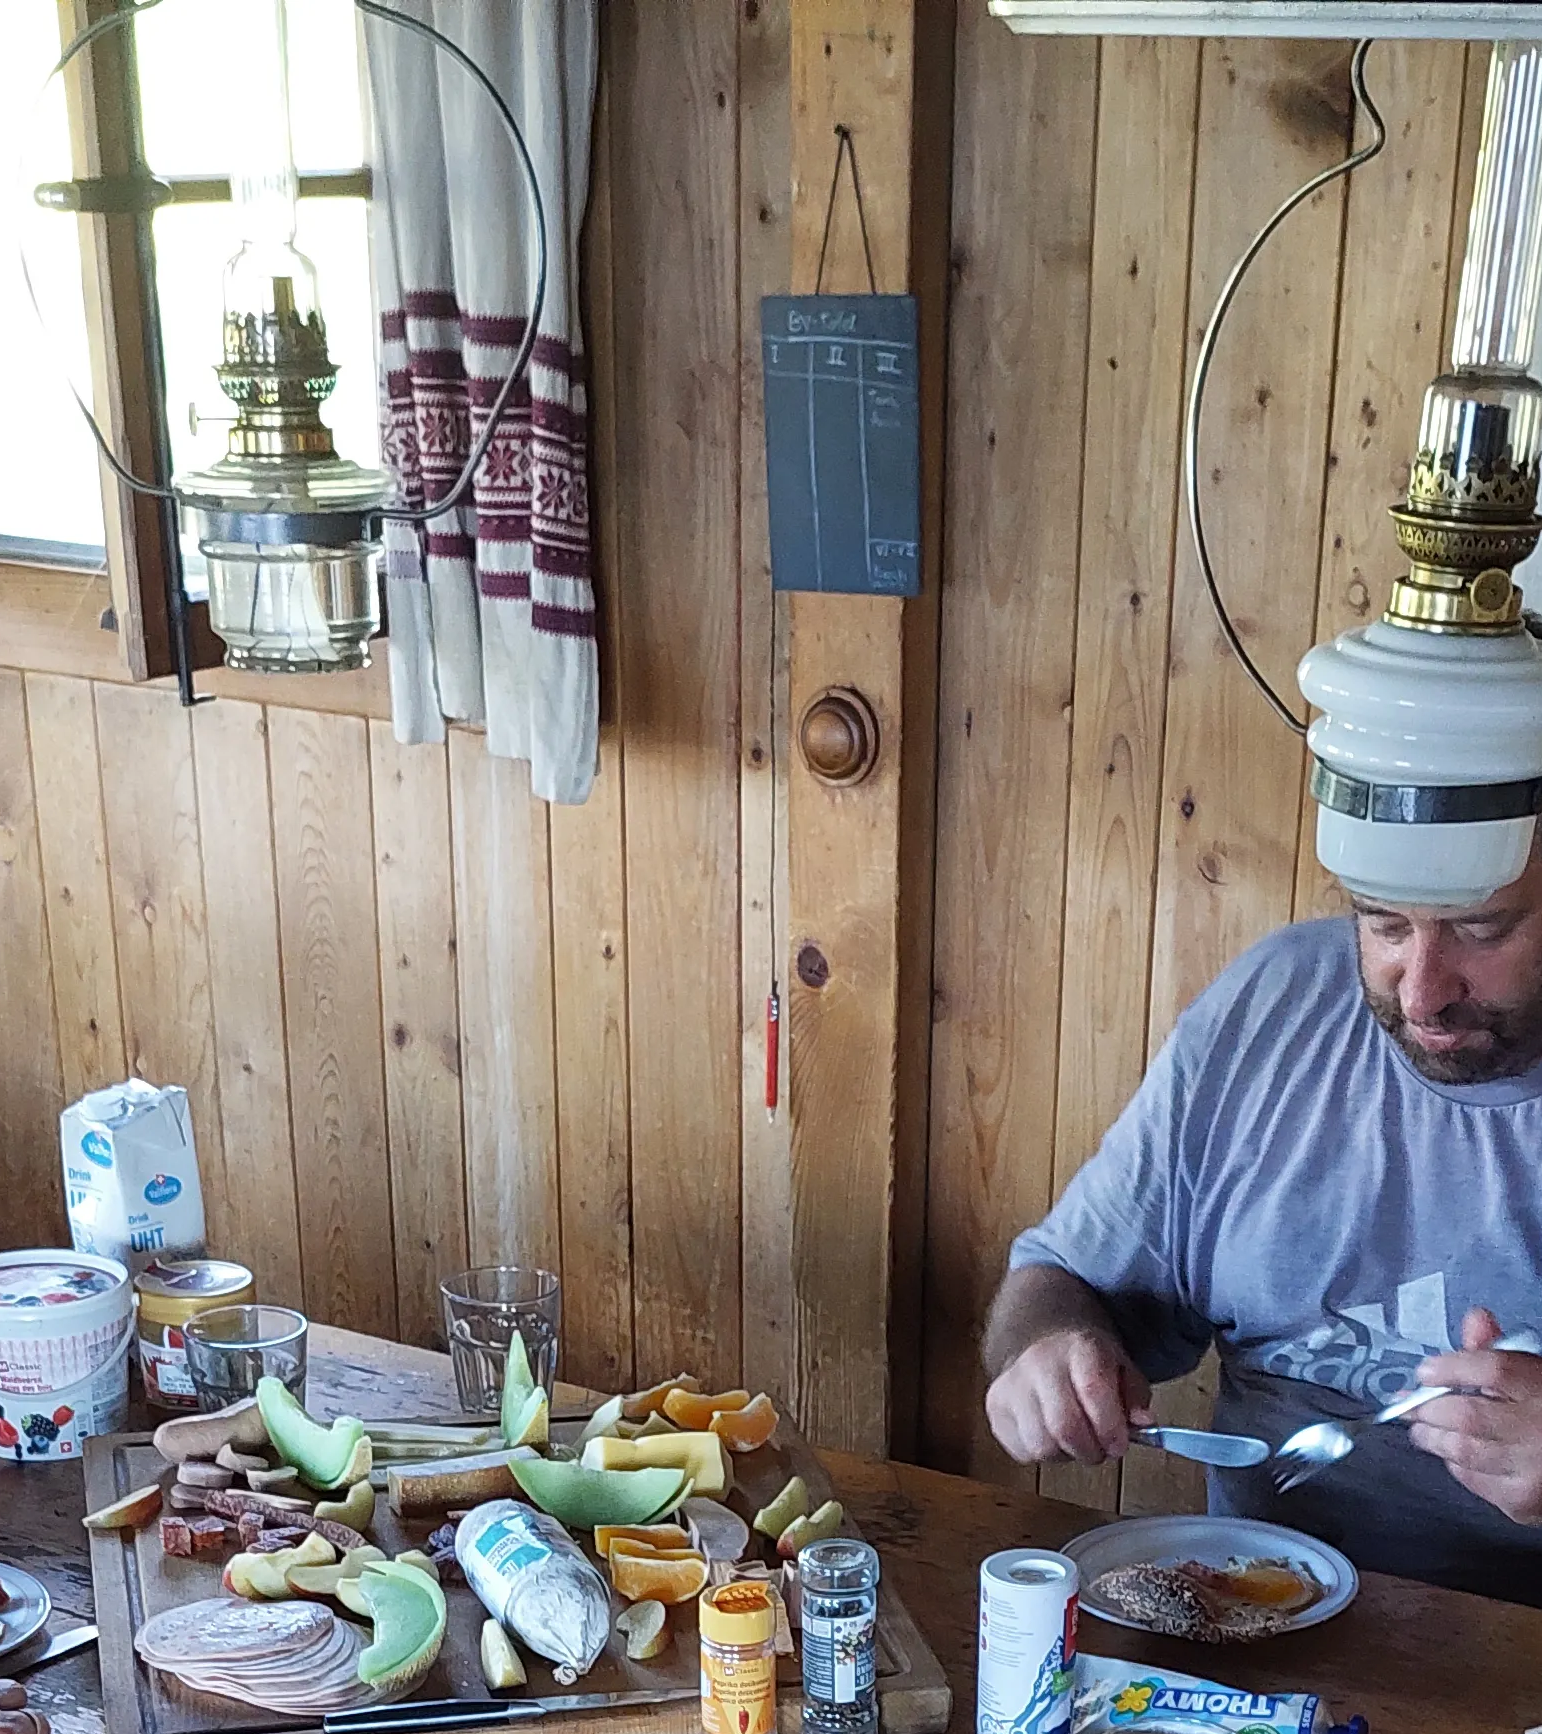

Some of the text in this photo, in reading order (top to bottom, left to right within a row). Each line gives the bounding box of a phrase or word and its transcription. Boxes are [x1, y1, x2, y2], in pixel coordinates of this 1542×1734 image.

[67, 1167, 92, 1182] Drink
[128, 1212, 149, 1225] Drink
[130, 1226, 165, 1254] UHT
[9, 1362, 42, 1372] Classic
[1156, 1688, 1272, 1716] THOMY
